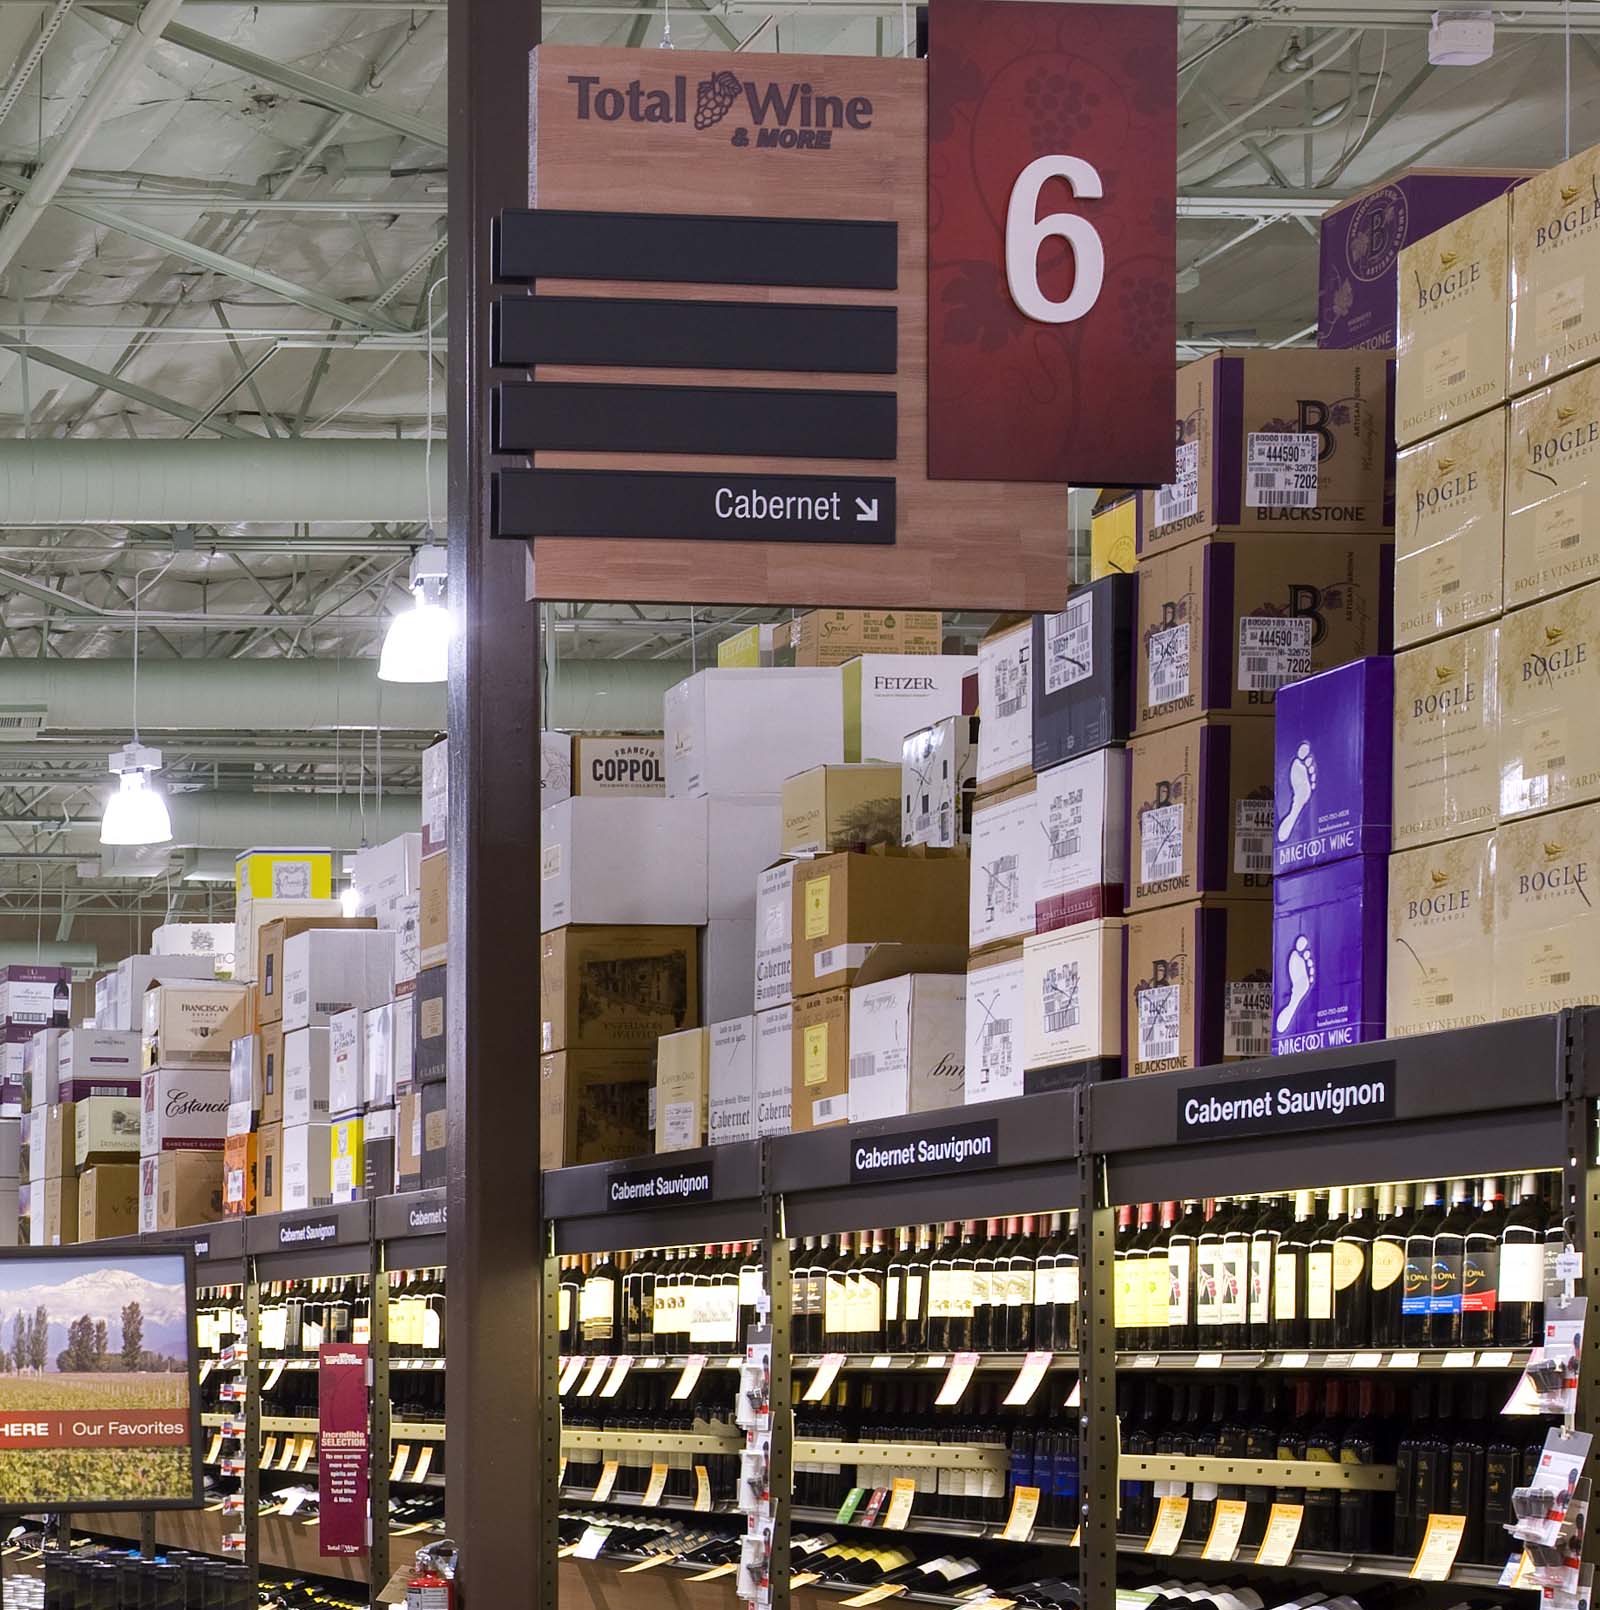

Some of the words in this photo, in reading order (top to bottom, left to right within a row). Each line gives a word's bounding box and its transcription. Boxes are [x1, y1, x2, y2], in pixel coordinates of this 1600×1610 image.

[568, 75, 686, 124] Total
[744, 82, 873, 130] Wine
[731, 128, 749, 146] &
[756, 128, 832, 150] MORE
[1005, 154, 1105, 323] 6
[1417, 262, 1480, 309] BOGLE
[1267, 446, 1299, 461] 444590
[1294, 474, 1317, 488] 7202
[714, 488, 841, 521] Cabernet
[1257, 506, 1366, 522] BLACKSTONE
[874, 676, 937, 691] FETZER
[1413, 681, 1476, 719] BOGLE
[592, 759, 665, 783] COPPOL
[1279, 838, 1327, 865] BAREFOOT
[1330, 831, 1354, 851] WINE
[1184, 1091, 1273, 1125] Cabernet
[1276, 1078, 1385, 1116] Sauvignon
[855, 1142, 915, 1171] Cabernet
[918, 1133, 992, 1163] Sauvignon
[611, 1178, 655, 1201] Cabernet
[656, 1173, 709, 1197] Sauvignon
[280, 1226, 304, 1243] Cabernet
[305, 1223, 336, 1240] Sauvignon
[72, 1421, 104, 1436] Our
[108, 1420, 184, 1436] Favorites
[323, 1431, 365, 1439] Incredible
[321, 1438, 365, 1446] SELECTION
